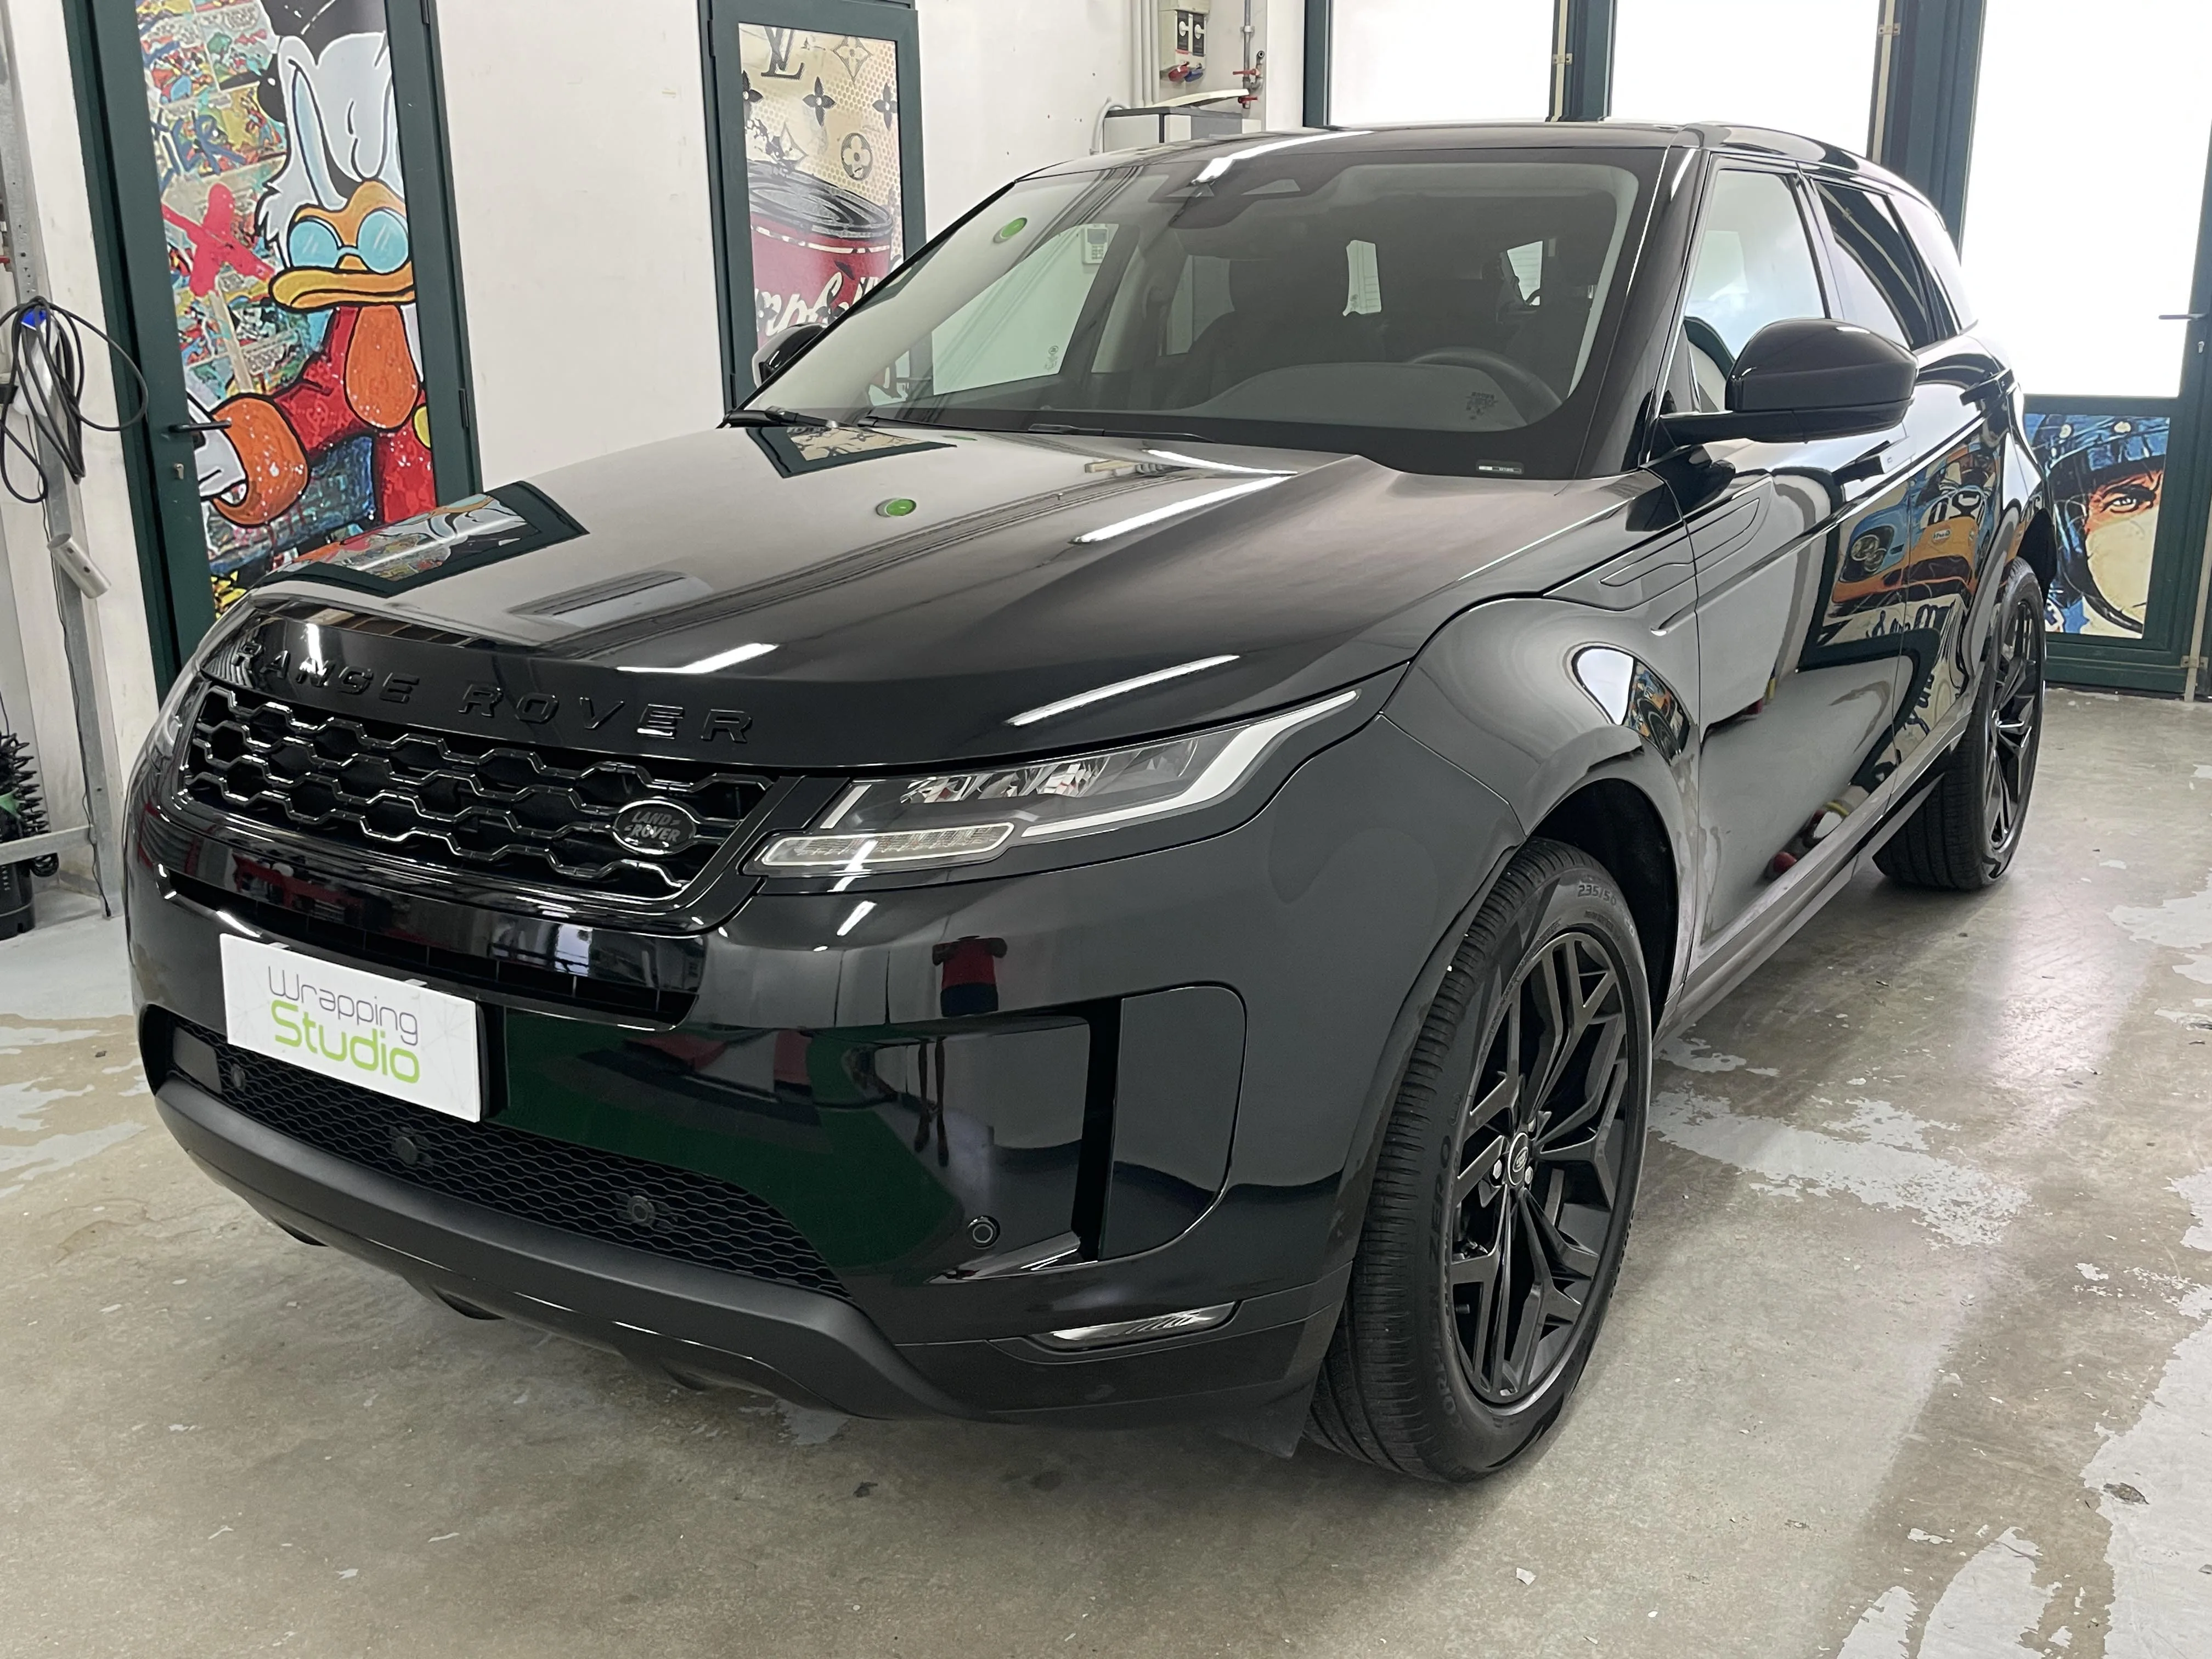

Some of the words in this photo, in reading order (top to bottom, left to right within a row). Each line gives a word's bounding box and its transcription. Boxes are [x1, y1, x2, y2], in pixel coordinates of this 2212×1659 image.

[232, 641, 420, 704] RANGE
[458, 683, 753, 743] ROVER
[629, 824, 681, 842] ROVER
[632, 811, 673, 826] LAND
[271, 1000, 420, 1084] Studio
